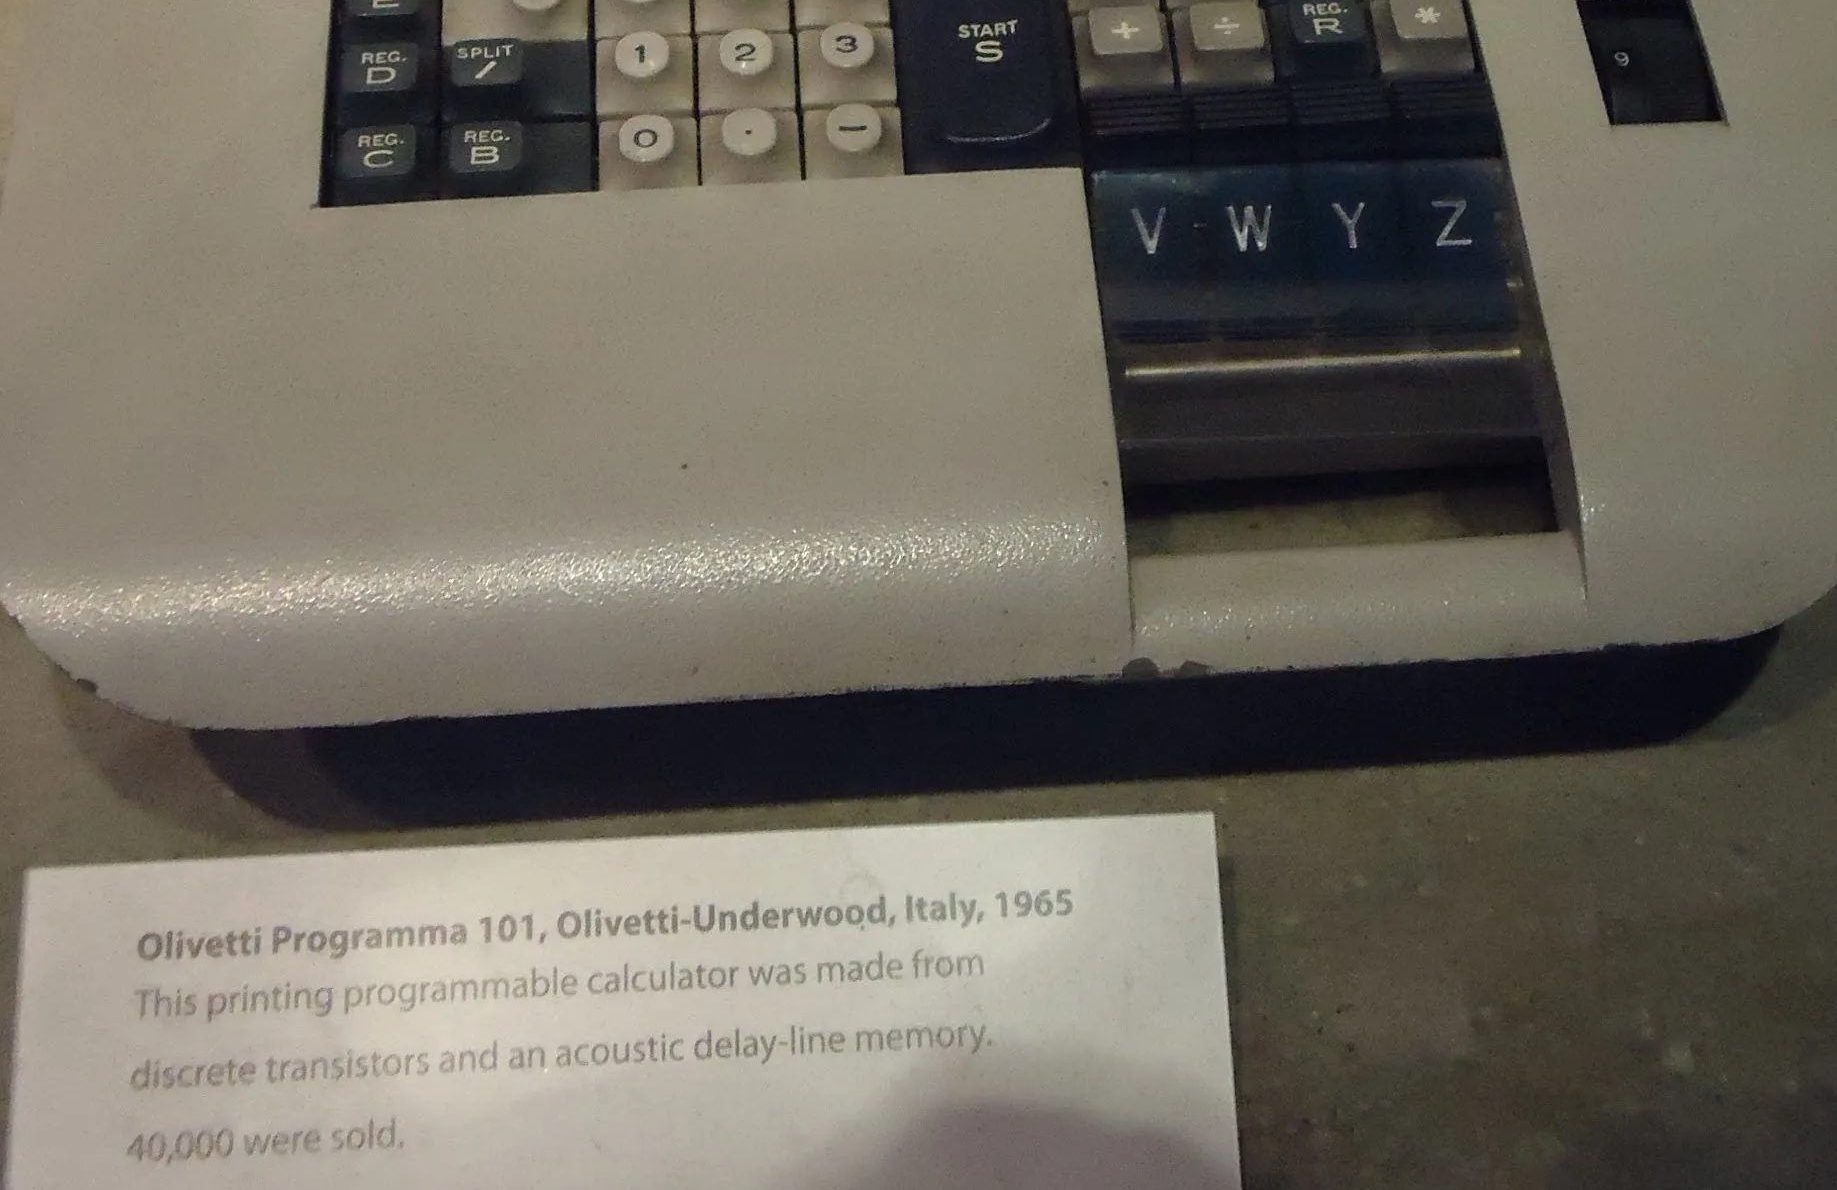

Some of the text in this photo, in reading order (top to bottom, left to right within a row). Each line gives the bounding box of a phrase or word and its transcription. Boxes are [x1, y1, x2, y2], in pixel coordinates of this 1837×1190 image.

[1302, 3, 1348, 16] REG.
[958, 19, 1018, 38] START
[1312, 18, 1343, 35] R
[456, 45, 514, 58] SPLIT
[734, 43, 757, 62] 2
[836, 35, 858, 53] 3
[974, 40, 1004, 62] S
[361, 51, 407, 64] REG.
[635, 45, 646, 63] 1
[366, 67, 396, 84] D
[357, 133, 405, 148] REG.
[463, 130, 512, 144] REG.
[363, 150, 394, 168] C
[470, 145, 500, 165] B
[1132, 207, 1166, 254] V
[1225, 205, 1272, 252] W
[1332, 202, 1365, 249] Y
[1431, 200, 1473, 247] Z
[137, 888, 1073, 962] Olivetti Programma 101, Olivetti-Underwood, Italy, 1965
[133, 948, 985, 1022] This printing programmable calculator was made from
[130, 1021, 993, 1091] discrete transistors and an acoustic delay-line memory.
[126, 1116, 405, 1166] 40,000 were sold.
